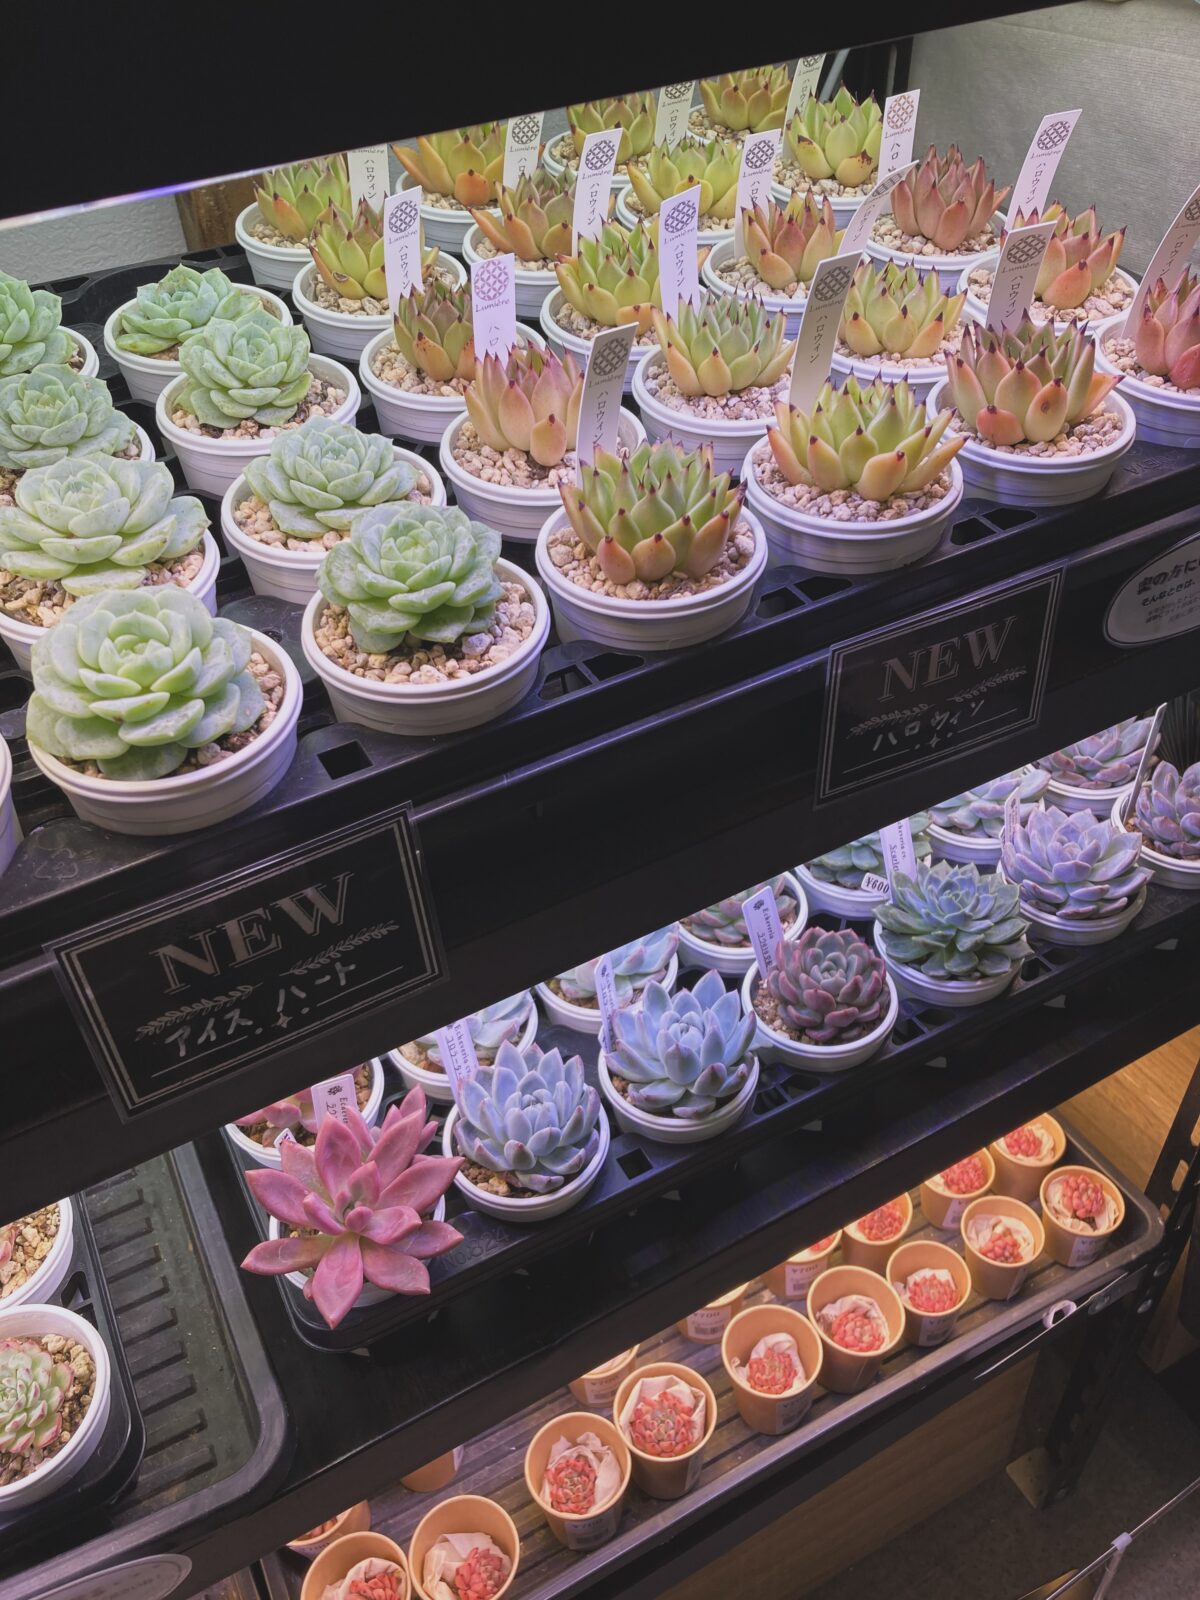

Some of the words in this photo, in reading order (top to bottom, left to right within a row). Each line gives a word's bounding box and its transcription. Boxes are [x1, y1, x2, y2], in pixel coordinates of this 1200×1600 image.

[364, 159, 377, 200] ハロウィン
[1025, 162, 1046, 204] ハロウィン
[587, 182, 600, 226] ハロウィン
[399, 245, 411, 290] ハロウィン
[673, 243, 685, 288] ハロウィン
[1160, 233, 1189, 277] ハロウィン
[1005, 275, 1025, 319] ハロウィン
[809, 315, 828, 364] ハロウィン
[594, 390, 609, 444] ハロウィン
[879, 616, 1017, 703] NEW
[872, 699, 986, 752] ハロウィン
[865, 876, 890, 895] ¥600
[148, 871, 355, 995] NEW
